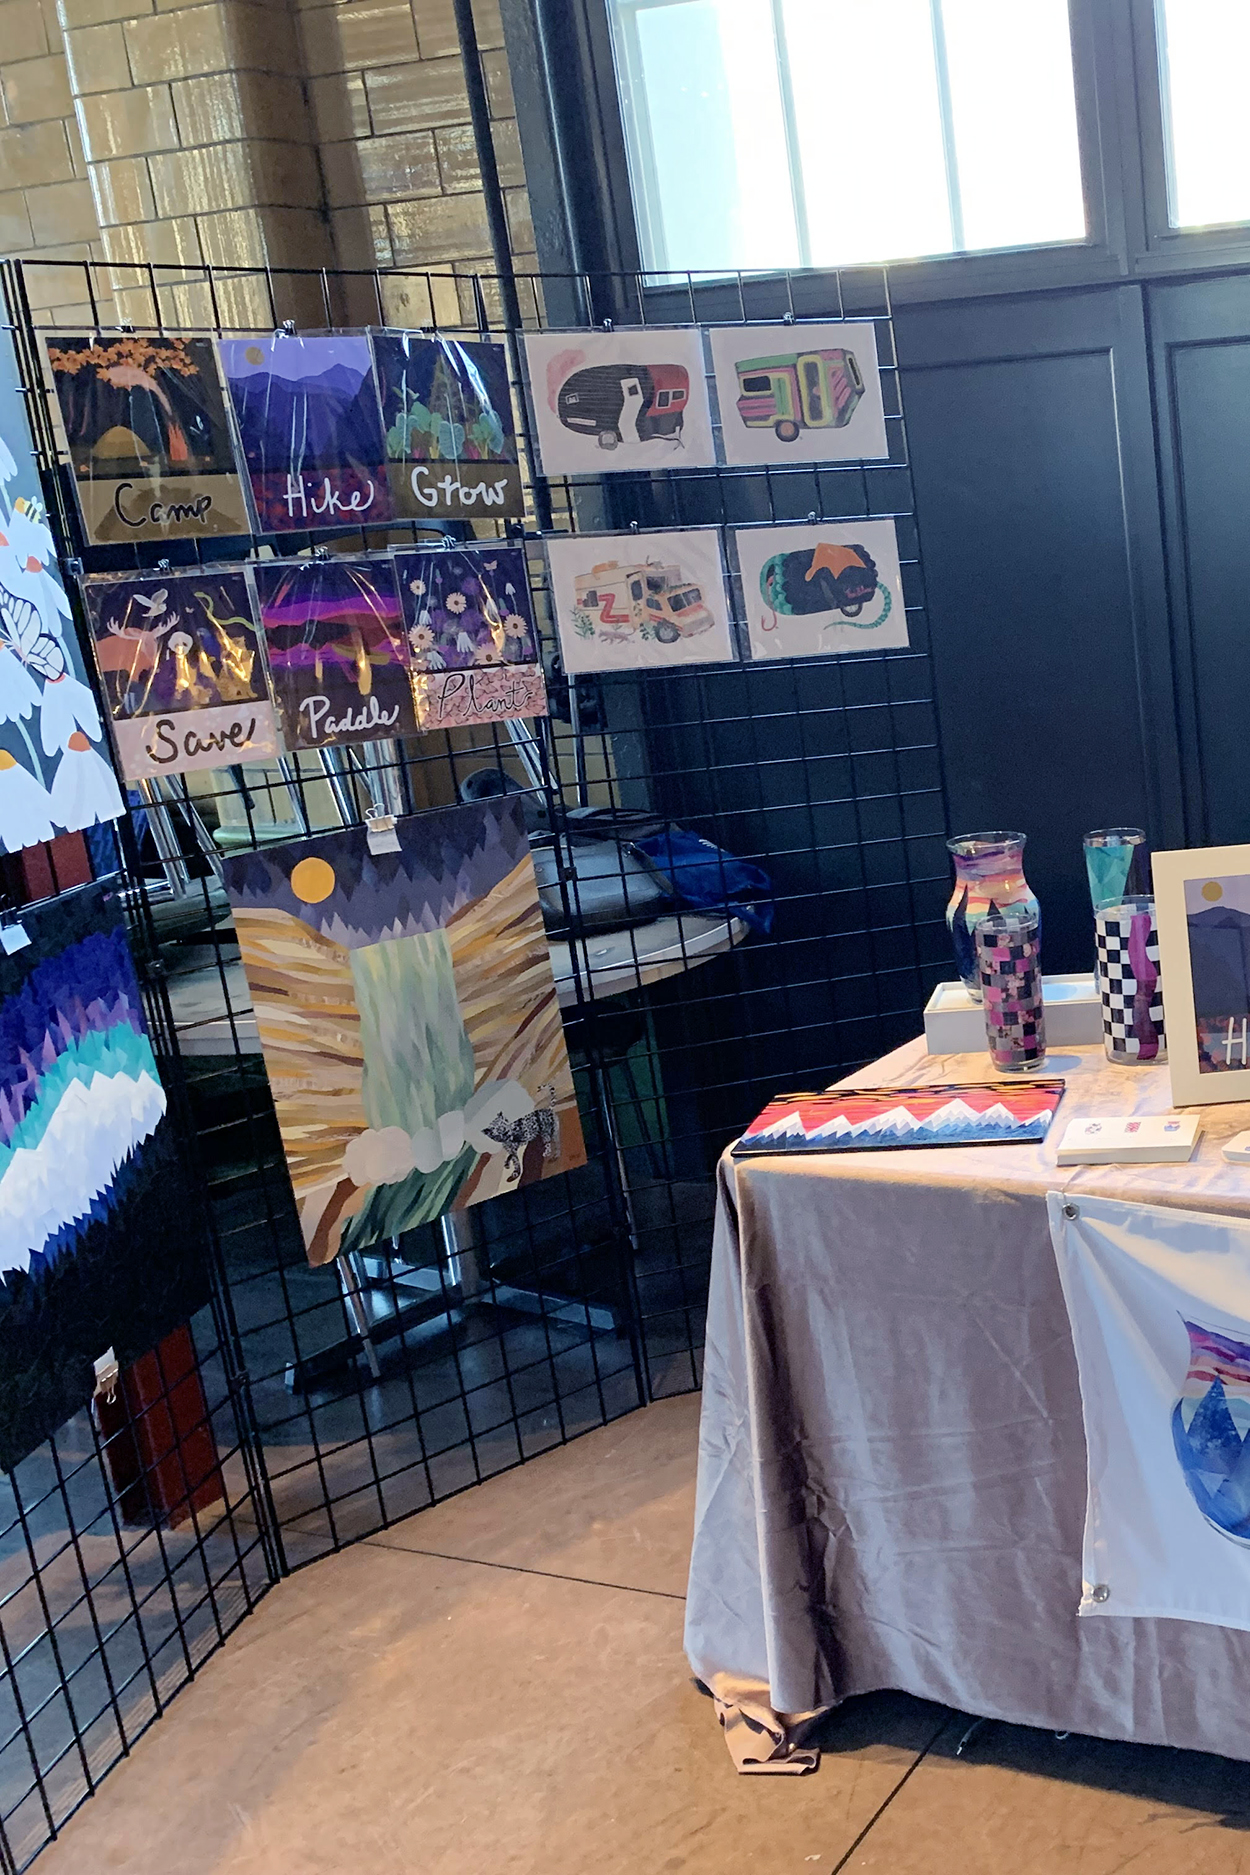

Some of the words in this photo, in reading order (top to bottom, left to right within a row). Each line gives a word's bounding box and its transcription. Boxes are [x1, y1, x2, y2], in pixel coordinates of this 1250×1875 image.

[114, 483, 212, 527] Camp
[283, 473, 374, 518] Hike
[411, 466, 507, 507] Grow
[300, 695, 399, 739] Paddle
[437, 673, 534, 717] Plant
[146, 717, 256, 765] Save
